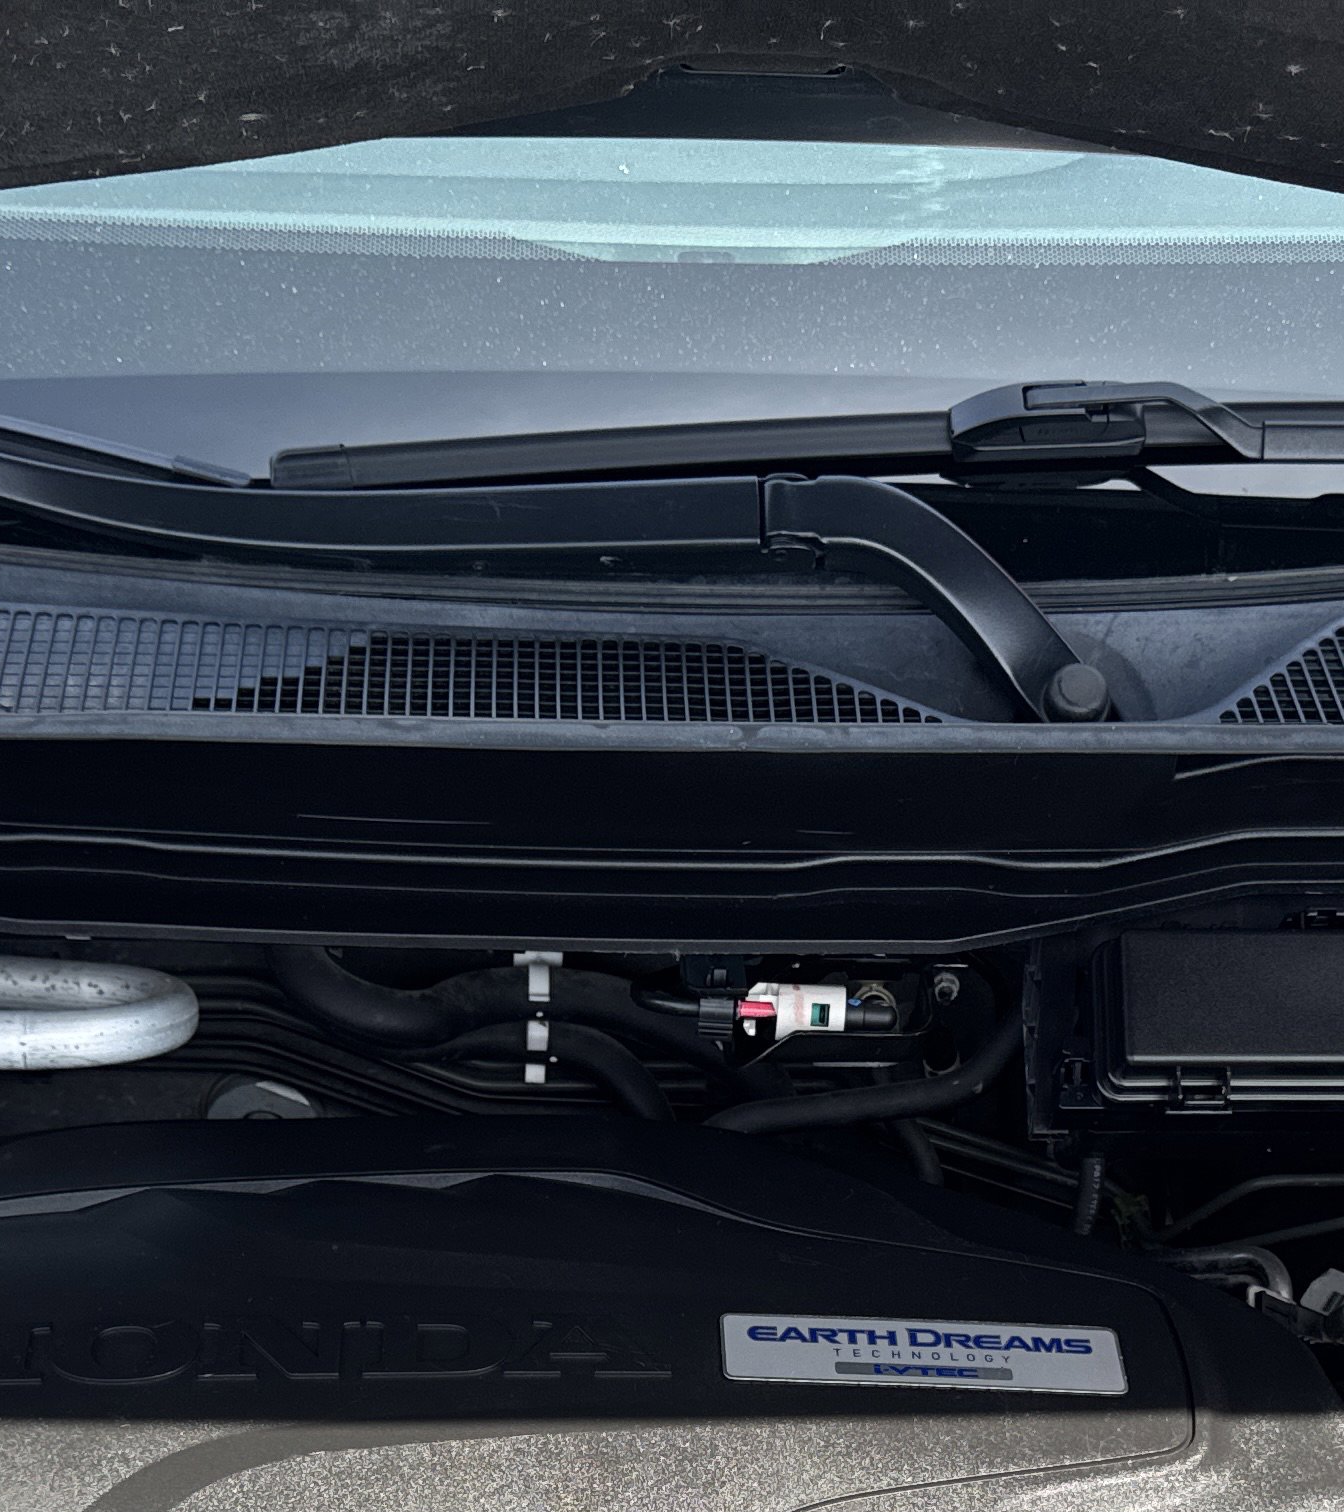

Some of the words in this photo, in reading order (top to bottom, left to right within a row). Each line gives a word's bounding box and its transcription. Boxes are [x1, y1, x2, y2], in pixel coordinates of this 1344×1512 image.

[747, 1325, 897, 1347] EARTH
[905, 1327, 1093, 1355] DREAMS
[833, 1347, 1011, 1364] TECHNOLOGY
[872, 1364, 979, 1379] i-VTEC
